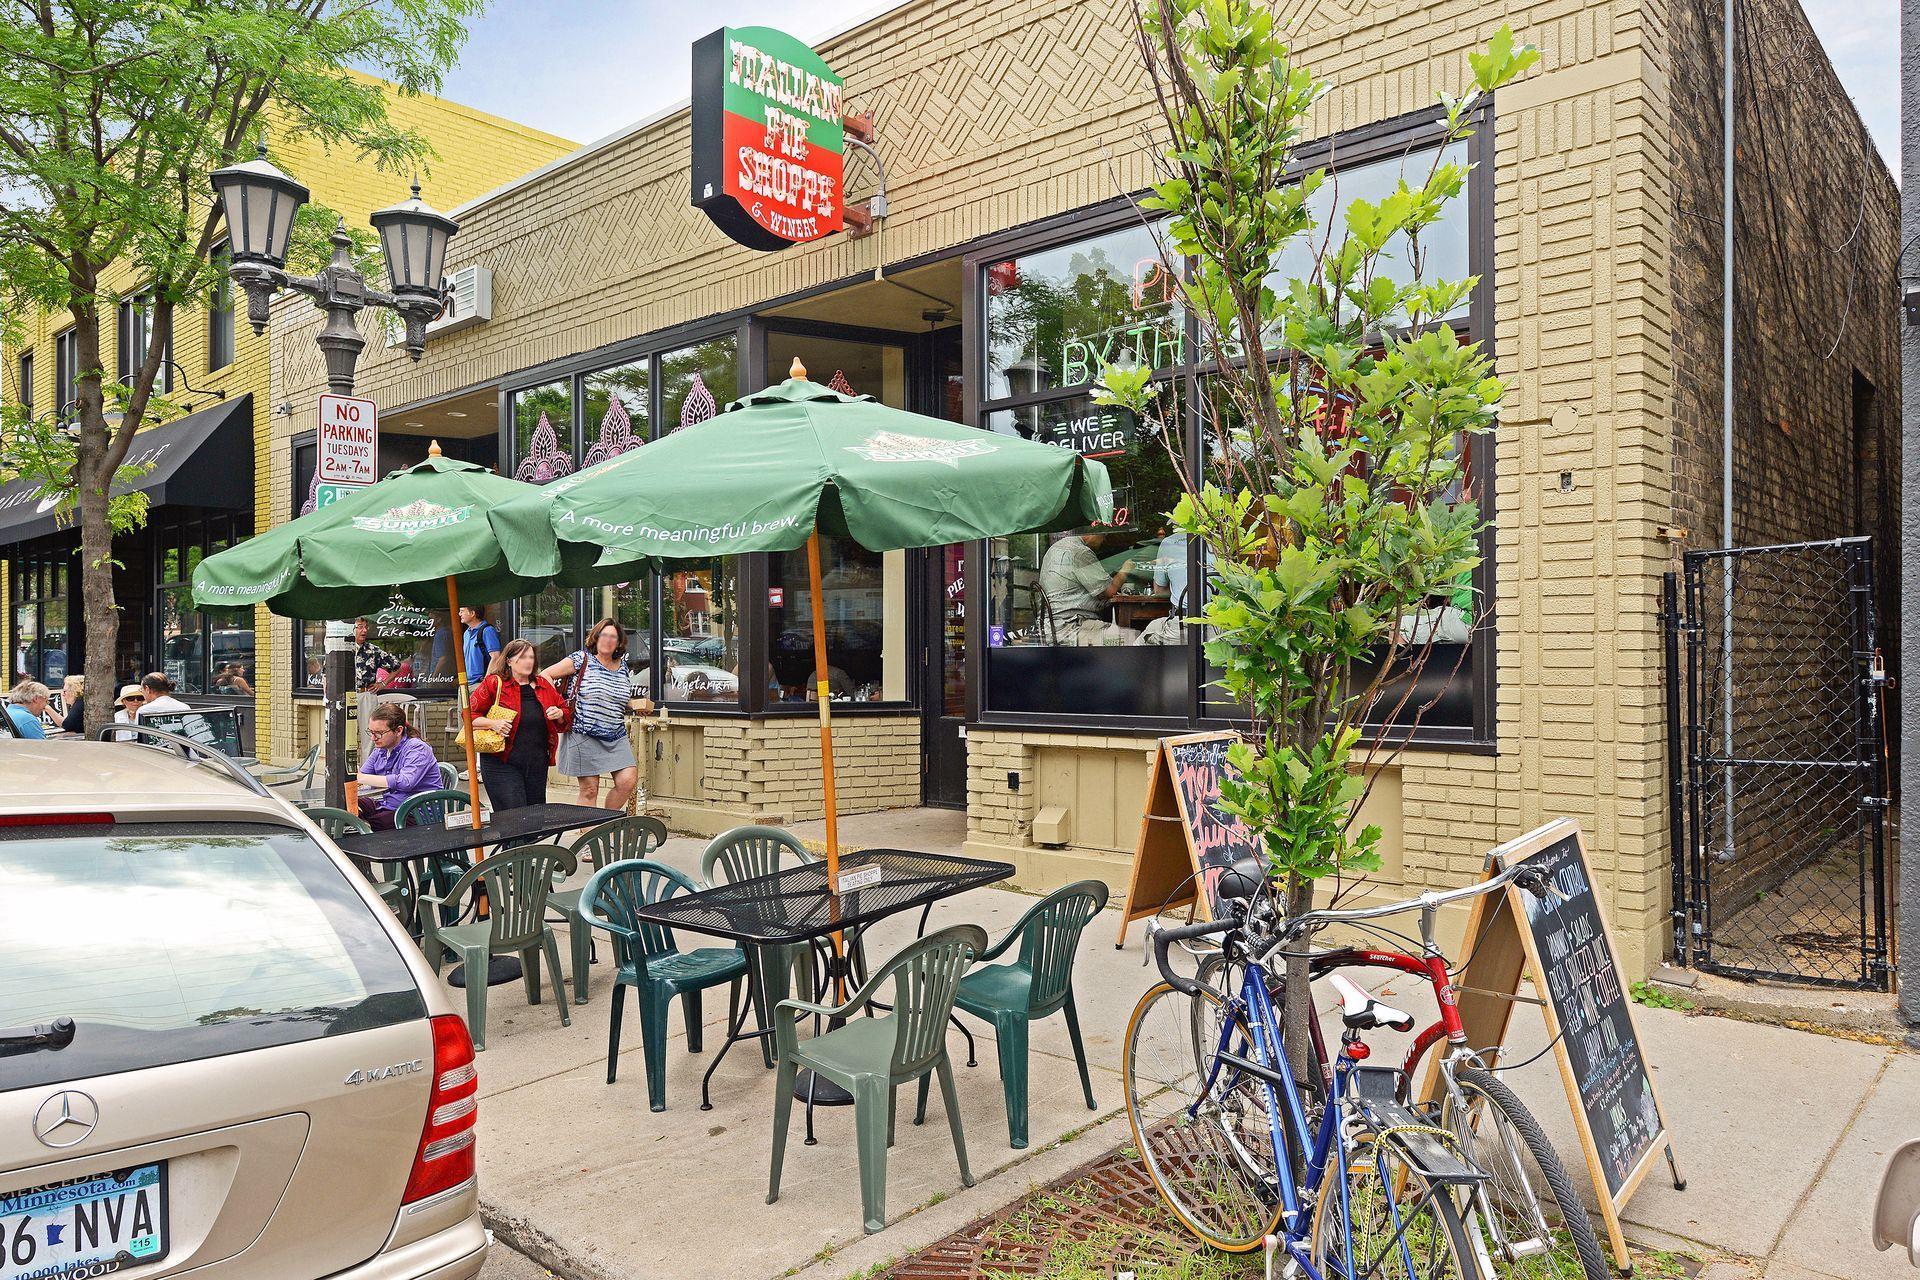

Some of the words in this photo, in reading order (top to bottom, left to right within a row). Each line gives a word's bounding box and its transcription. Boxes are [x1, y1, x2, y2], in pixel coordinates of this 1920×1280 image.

[729, 38, 843, 126] ITALIAN
[764, 104, 811, 161] PIE
[738, 146, 836, 218] SHOPPE
[751, 201, 768, 223] &
[769, 210, 819, 237] WINERY
[336, 404, 360, 422] NO
[324, 424, 372, 444] PARKING
[1070, 415, 1100, 434] WE
[327, 442, 369, 458] TUESDAYS
[324, 490, 334, 506] 2
[559, 510, 575, 525] A
[582, 516, 634, 536] more
[639, 521, 746, 544] meaningful
[750, 514, 800, 536] brew.
[196, 581, 205, 591] A
[208, 585, 235, 595] more
[376, 614, 435, 630] Catering
[376, 626, 436, 637] Take-out
[670, 675, 730, 697] Vegetarian
[2, 1179, 136, 1214] Minnesota.com
[74, 1189, 154, 1252] NVA
[138, 1238, 151, 1248] 15
